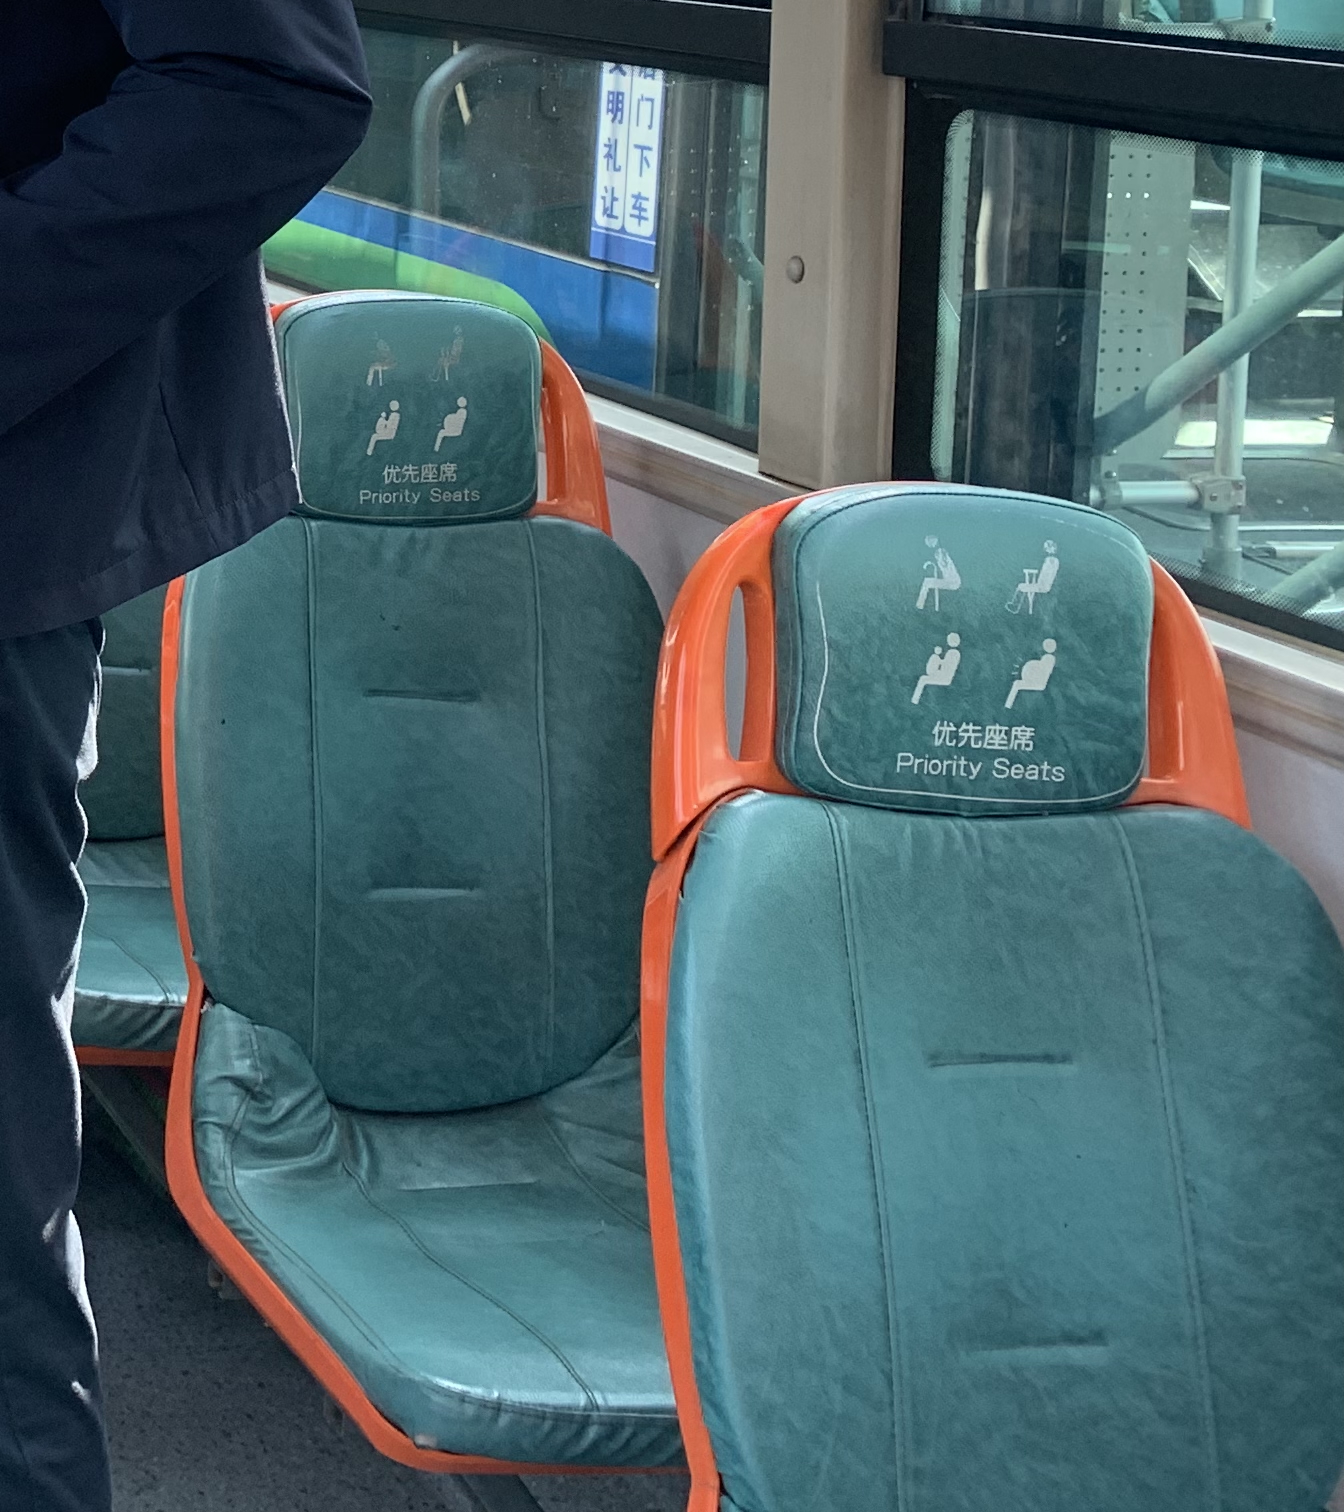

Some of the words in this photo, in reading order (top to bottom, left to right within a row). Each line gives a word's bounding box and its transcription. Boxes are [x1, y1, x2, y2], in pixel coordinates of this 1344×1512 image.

[382, 463, 458, 485] 优先座席
[359, 489, 421, 505] Priority
[430, 487, 481, 503] Seats
[932, 720, 1035, 752] 优先座席
[896, 752, 982, 780] Priority
[993, 758, 1066, 783] Seats
